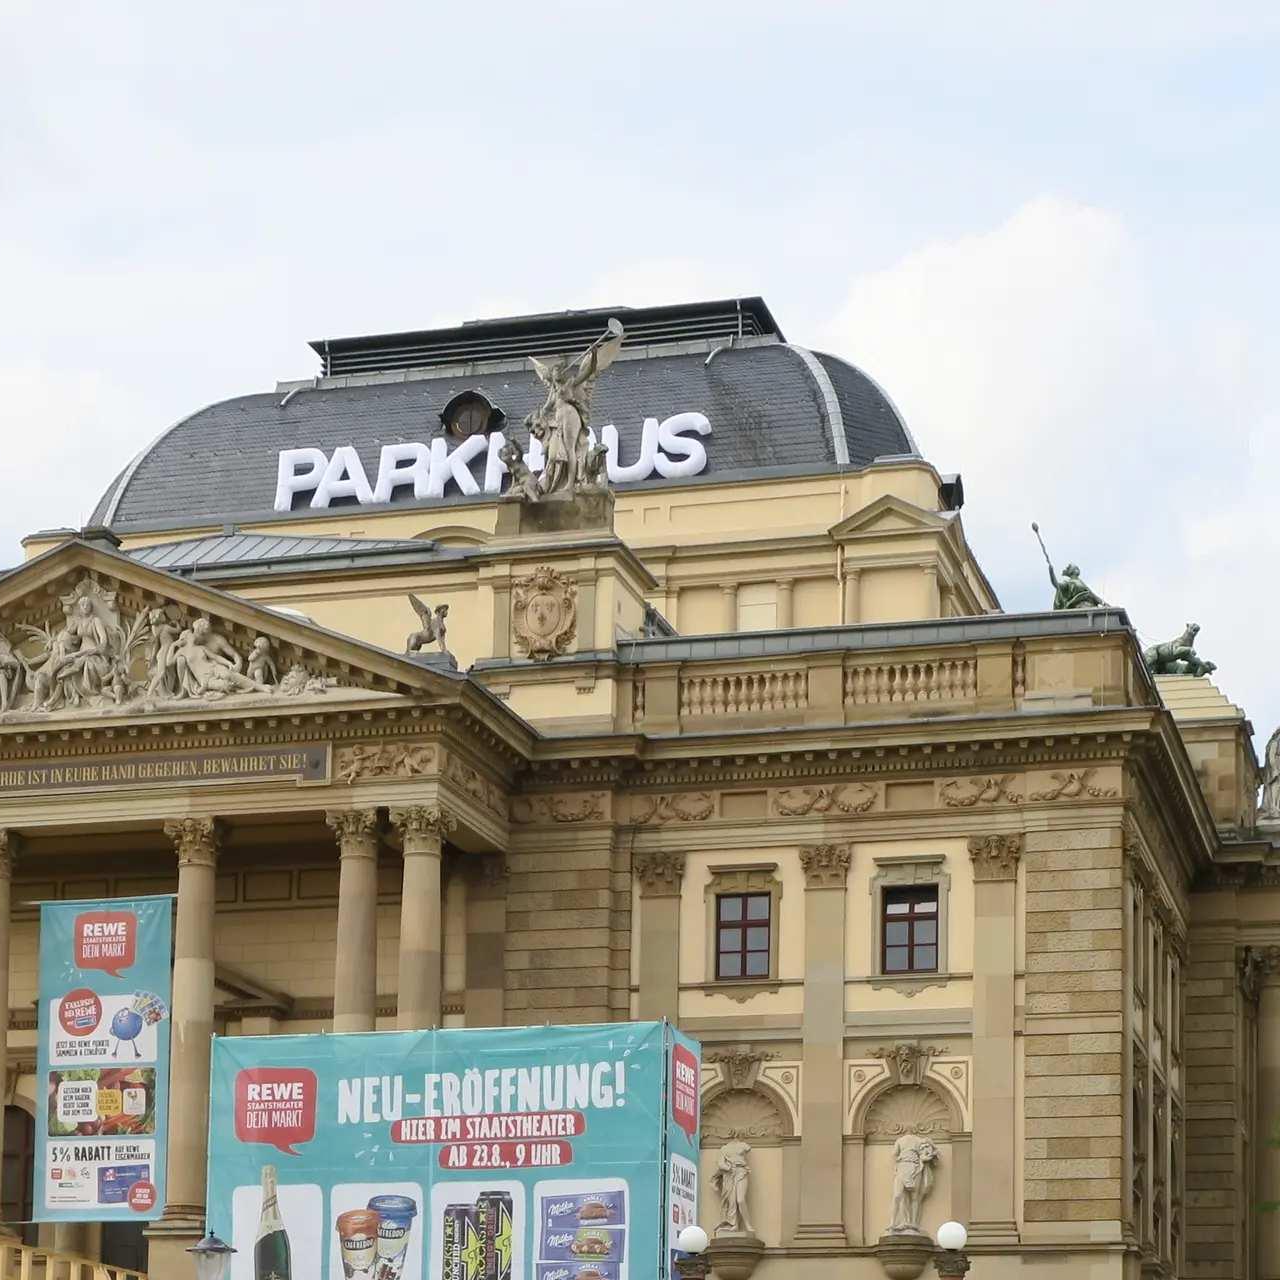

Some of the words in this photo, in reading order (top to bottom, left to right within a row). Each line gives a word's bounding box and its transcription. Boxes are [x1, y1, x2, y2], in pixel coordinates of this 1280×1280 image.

[273, 411, 712, 512] PARKHUS
[28, 769, 47, 785] IST
[51, 767, 64, 783] IN
[65, 766, 99, 782] EURE
[102, 764, 135, 781] HAND
[138, 760, 202, 778] GEGEBEN,
[203, 755, 277, 774] BEWAHRET
[279, 753, 308, 769] SIE!
[83, 922, 127, 936] REWE
[82, 943, 100, 958] DEIN
[102, 942, 126, 957] MARKT
[247, 1083, 304, 1100] REWE
[337, 1061, 626, 1125] NEU-ERÖFFNUNG!
[247, 1101, 303, 1110] STAATSTHEATER
[246, 1111, 268, 1128] DEIN
[271, 1110, 303, 1128] MARKT
[401, 1119, 435, 1140] HIER
[440, 1118, 461, 1140] IM
[466, 1114, 576, 1139] STAATSTHEATER
[74, 1146, 112, 1161] RABATT
[448, 1145, 468, 1167] AB
[515, 1143, 526, 1166] 9
[531, 1143, 561, 1165] UHR
[548, 1201, 574, 1216] Milka
[547, 1232, 574, 1247] Milka
